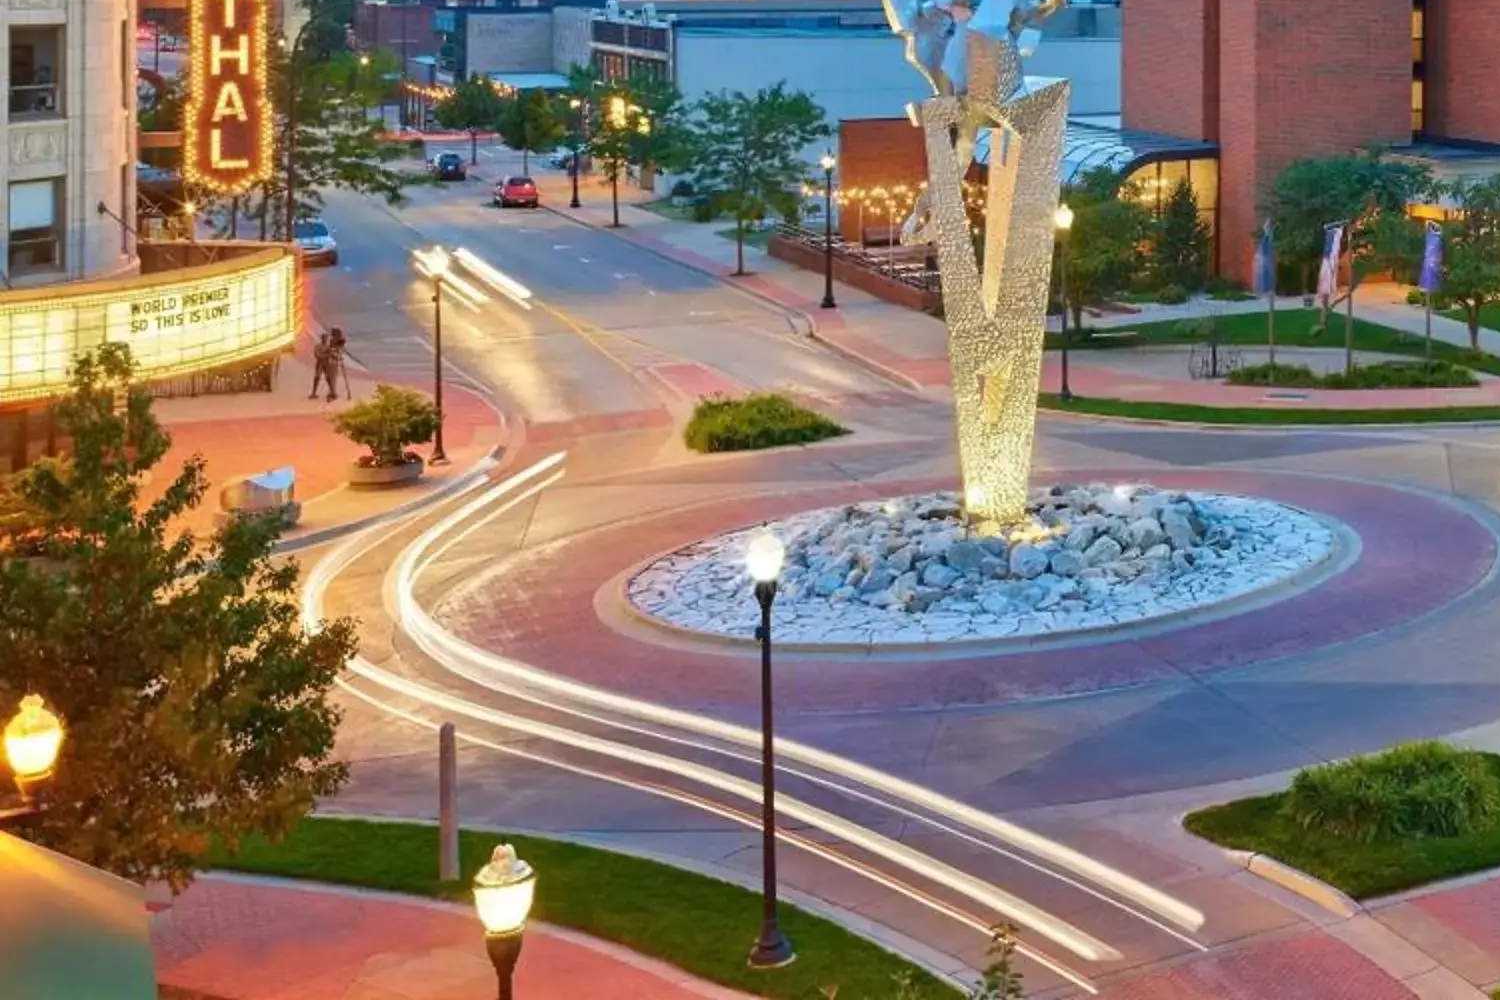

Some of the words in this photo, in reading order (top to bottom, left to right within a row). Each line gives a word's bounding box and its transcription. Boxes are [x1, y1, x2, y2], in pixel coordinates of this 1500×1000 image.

[131, 297, 177, 316] WORLD
[131, 319, 149, 334] SO
[155, 313, 184, 329] THIS
[189, 309, 201, 324] IS
[205, 303, 231, 321] LOVE
